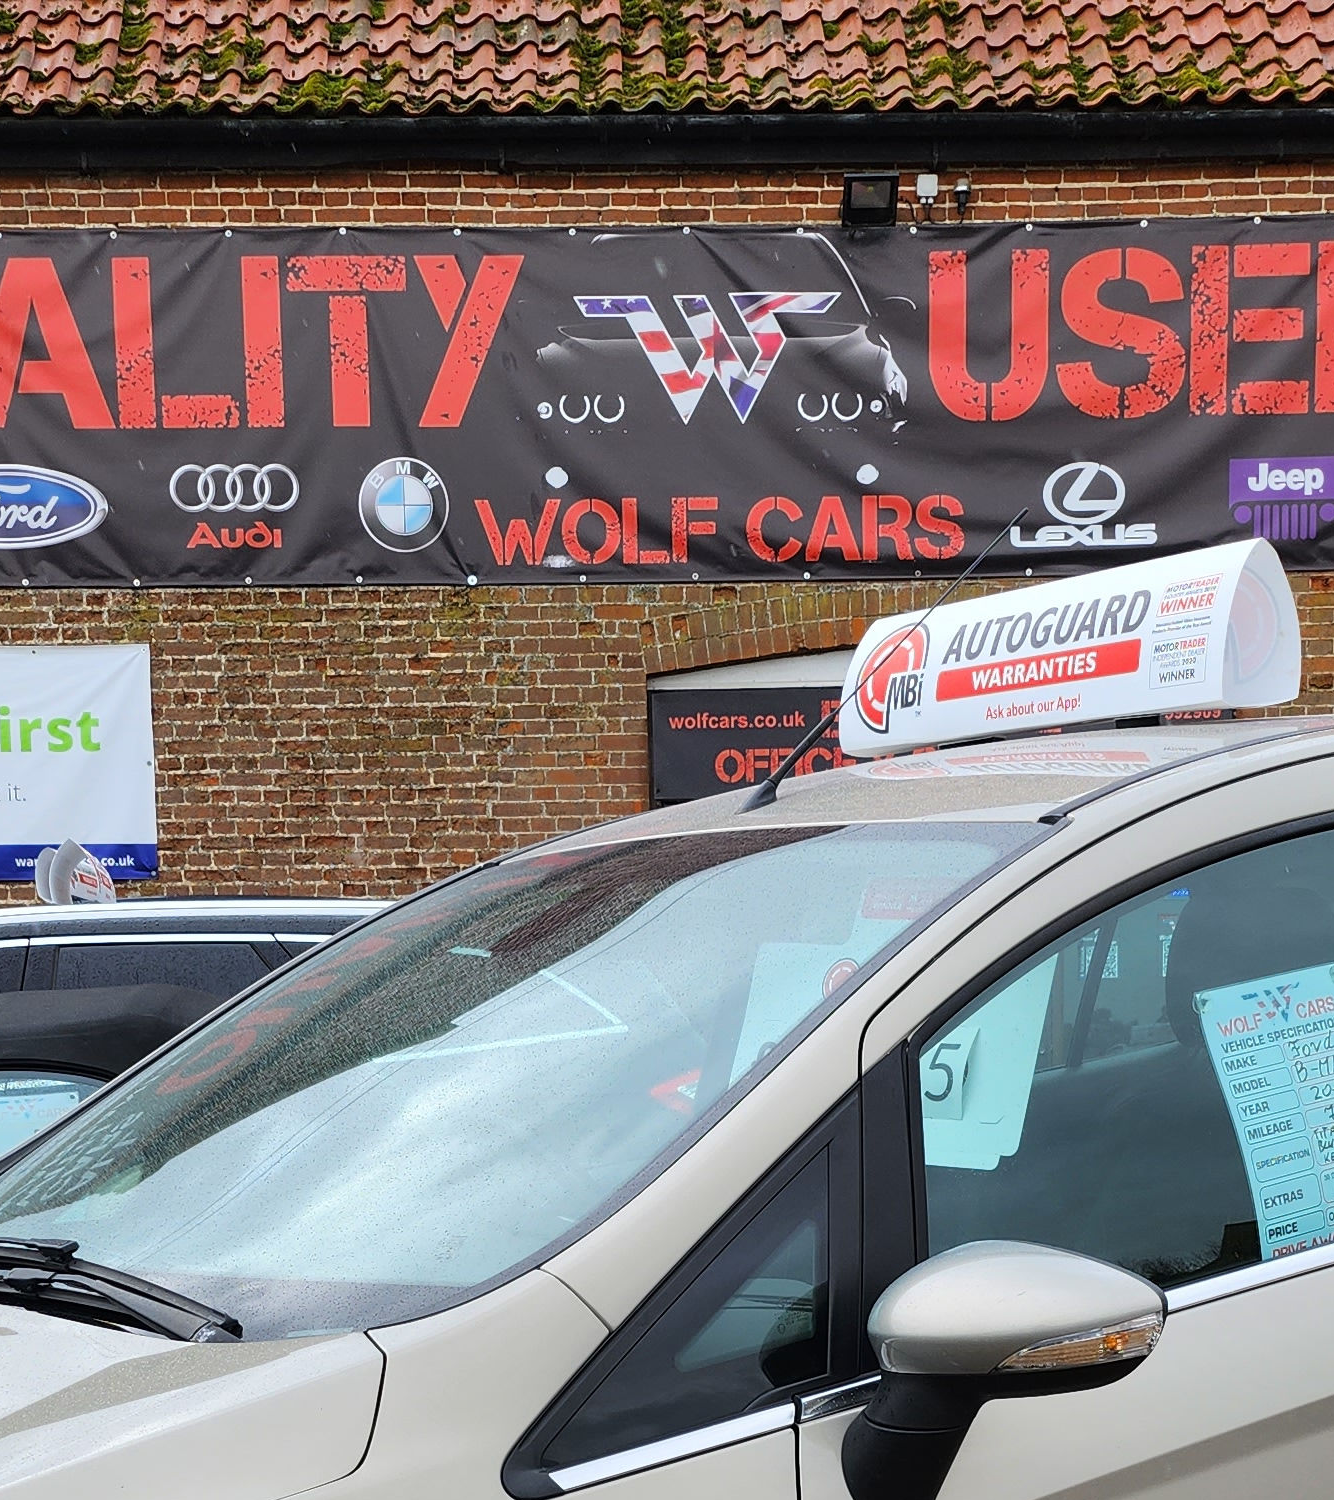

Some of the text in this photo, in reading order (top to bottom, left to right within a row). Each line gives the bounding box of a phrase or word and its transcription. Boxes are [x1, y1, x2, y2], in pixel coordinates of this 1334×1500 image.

[368, 461, 440, 490] BMW
[1248, 464, 1323, 496] Jeep
[186, 522, 283, 550] Audi
[474, 494, 966, 567] WOLF CARS
[1011, 523, 1158, 548] LEXUS
[1160, 593, 1215, 614] WINNER
[942, 589, 1153, 664] AUTOGUARD
[972, 651, 1097, 691] WARRANTIES
[1159, 668, 1196, 683] WINNER
[887, 673, 924, 710] MBi
[985, 694, 1081, 720] Ask about our App!
[668, 711, 806, 730] wolfcars.co.uk
[7, 783, 27, 803] it.
[1217, 1012, 1263, 1037] WOLF
[1221, 1034, 1266, 1054] VEHICLE
[1224, 1055, 1258, 1073] MAKE
[1232, 1077, 1272, 1095] MODEL
[1240, 1101, 1270, 1117] YEAR
[1247, 1119, 1294, 1141] MILEAGE
[1255, 1148, 1311, 1169] SPECIFICATION
[1264, 1188, 1304, 1210] EXTRAS
[1268, 1221, 1299, 1240] PRICE
